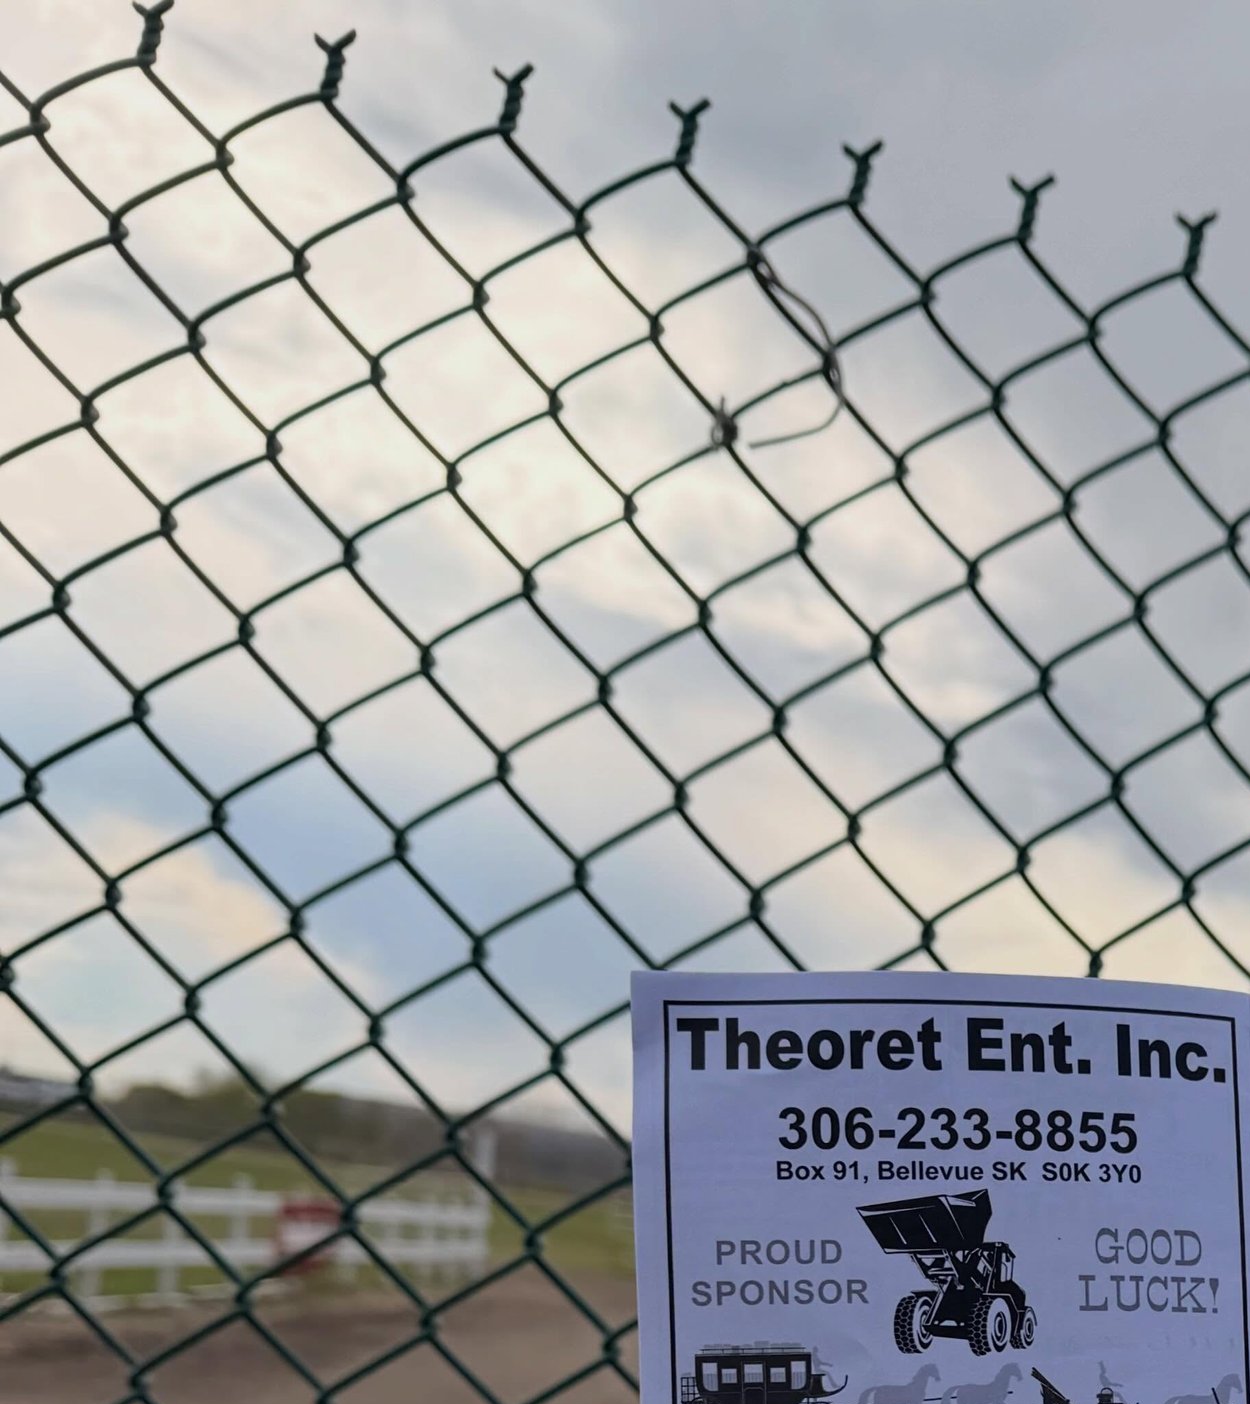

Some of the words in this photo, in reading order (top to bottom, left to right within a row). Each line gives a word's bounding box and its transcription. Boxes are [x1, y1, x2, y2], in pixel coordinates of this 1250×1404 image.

[676, 1017, 942, 1071] Theoret
[967, 1018, 1092, 1073] Ent.
[1117, 1024, 1225, 1083] Inc.
[779, 1107, 1137, 1153] 306-233-8855
[777, 1161, 825, 1180] Box
[833, 1161, 868, 1183] 91,
[878, 1161, 983, 1180] Bellevue
[992, 1161, 1027, 1180] SK
[717, 1240, 841, 1265] PROUD
[1095, 1228, 1201, 1266] GOOD
[692, 1280, 868, 1306] SPONSOR
[1079, 1275, 1219, 1313] LUCK!
